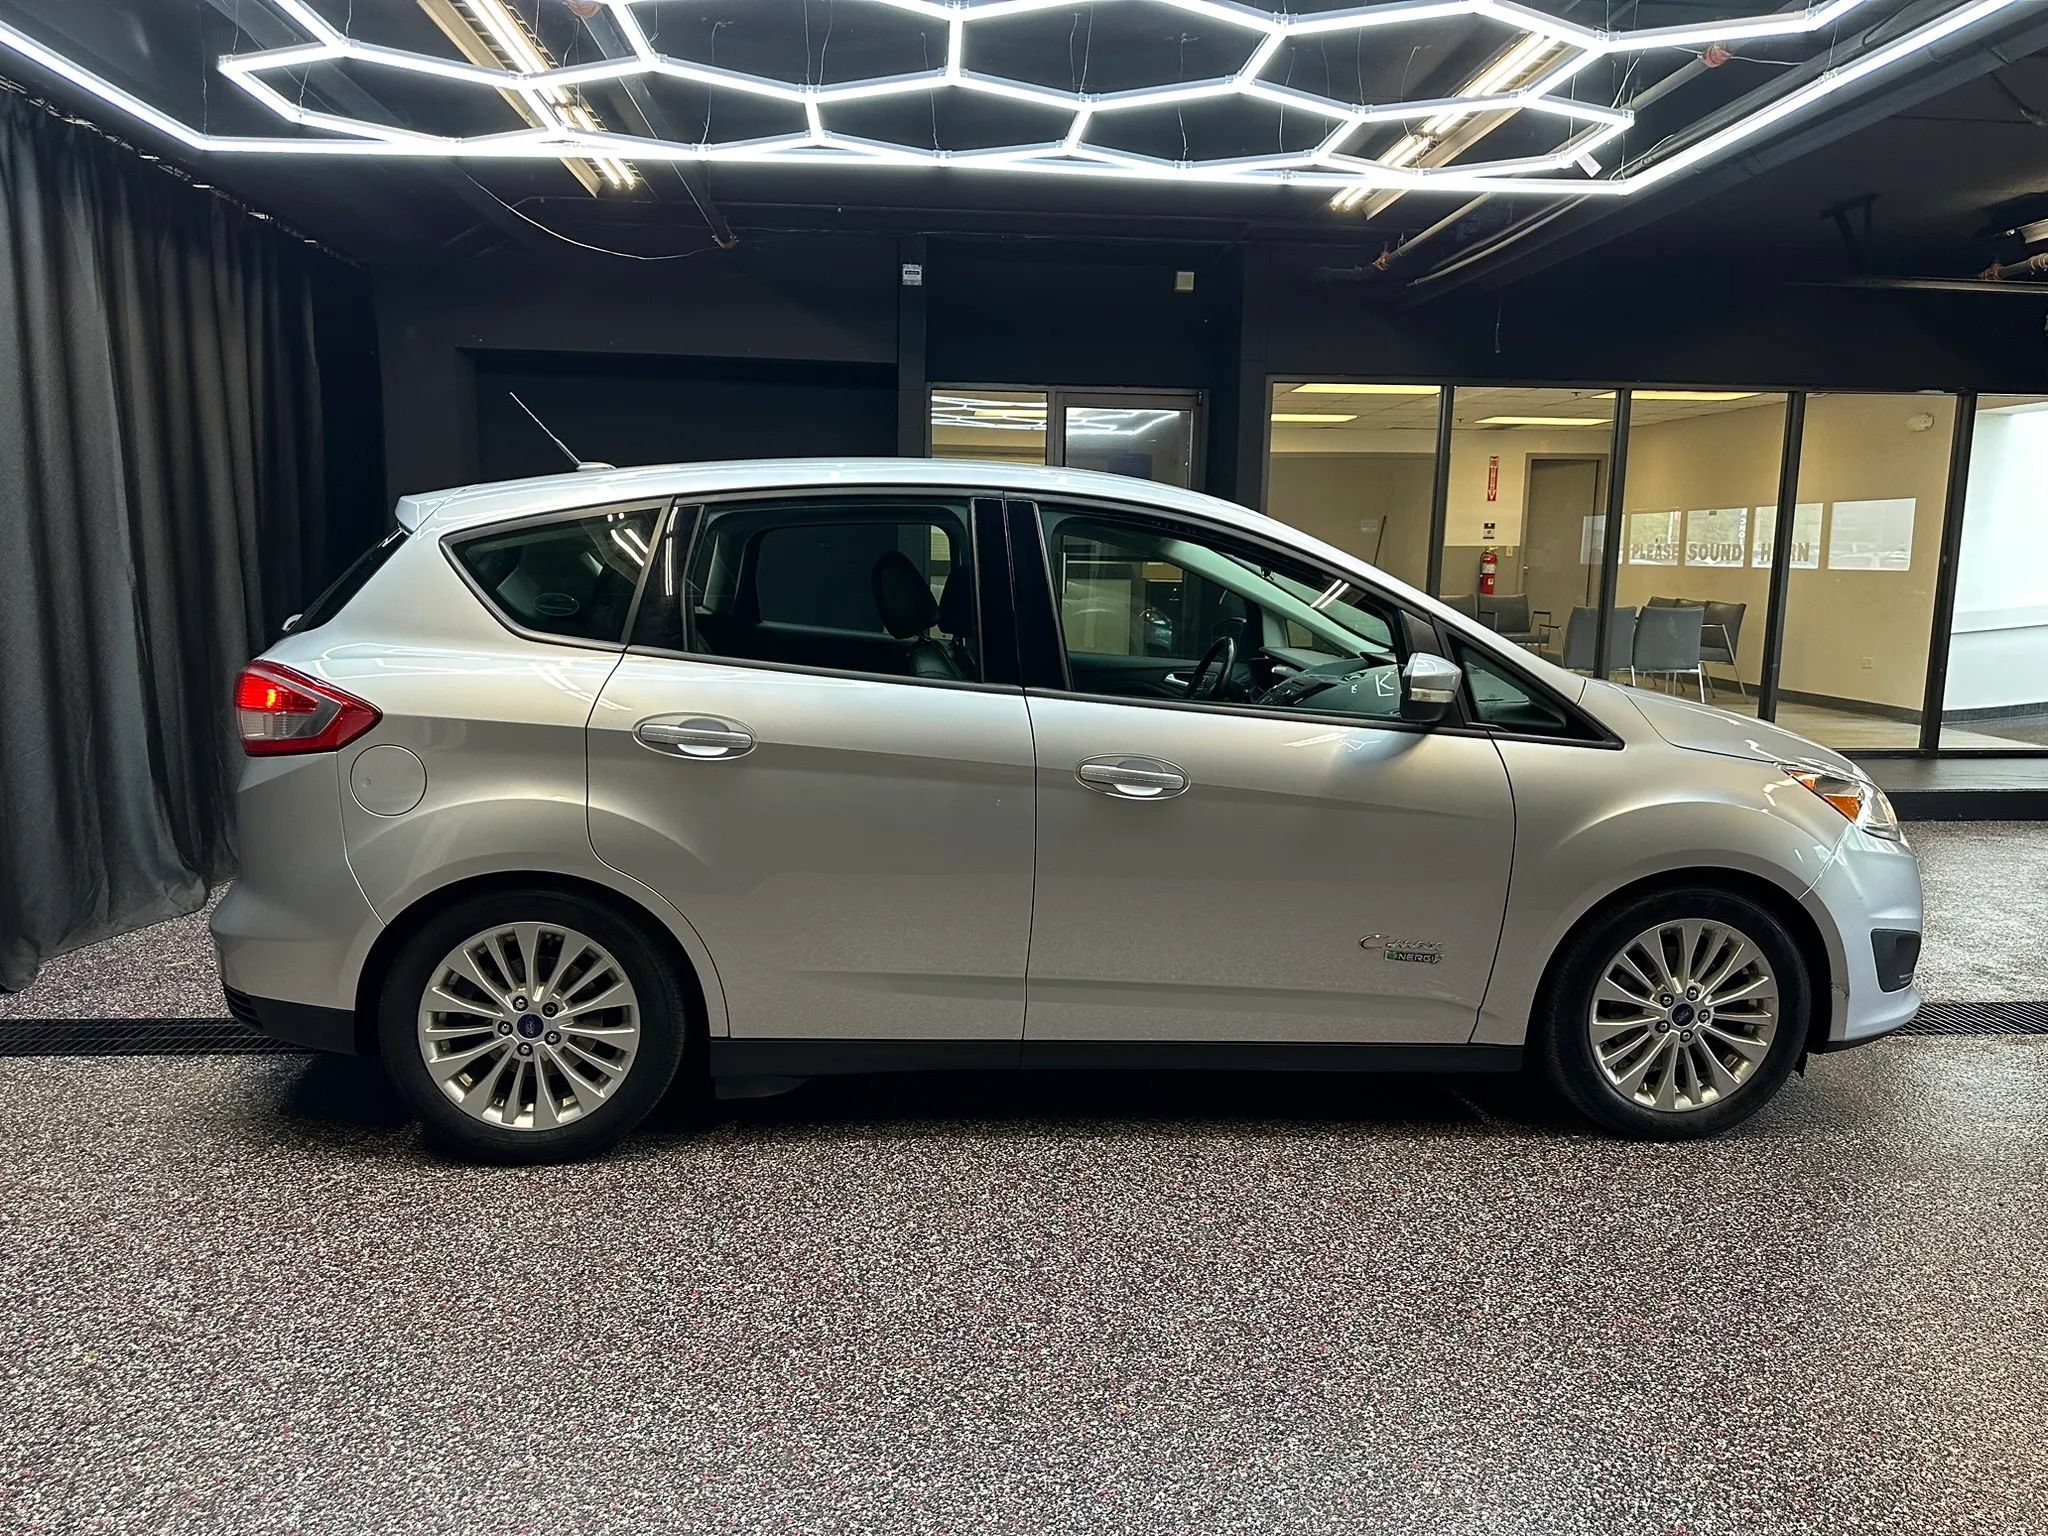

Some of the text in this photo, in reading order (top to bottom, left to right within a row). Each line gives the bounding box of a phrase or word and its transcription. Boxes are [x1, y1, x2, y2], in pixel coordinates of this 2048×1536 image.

[1632, 542, 1810, 562] PLEASE SOUND HN
